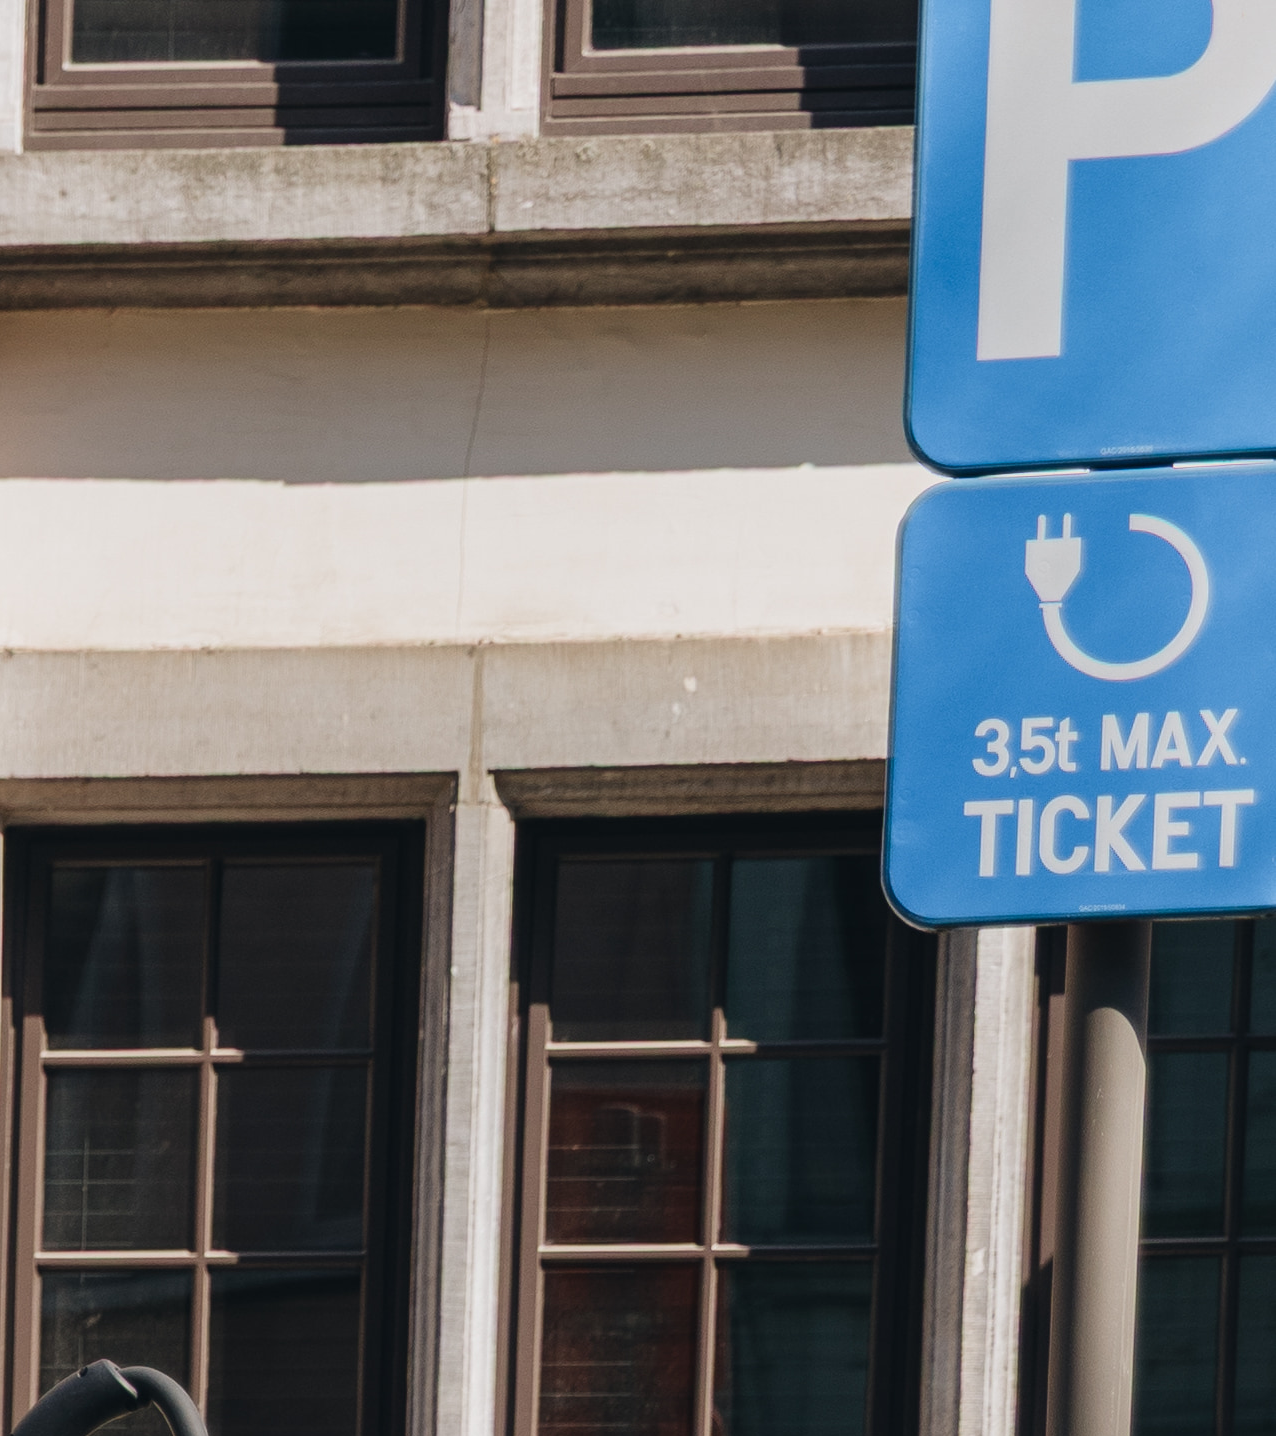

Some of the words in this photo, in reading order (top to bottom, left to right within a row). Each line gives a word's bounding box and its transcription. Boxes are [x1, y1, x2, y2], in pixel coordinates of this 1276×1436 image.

[976, 0, 1276, 362] P
[972, 716, 1079, 778] 3,5t
[1100, 708, 1247, 772] MAX.
[963, 788, 1255, 878] TICKET
